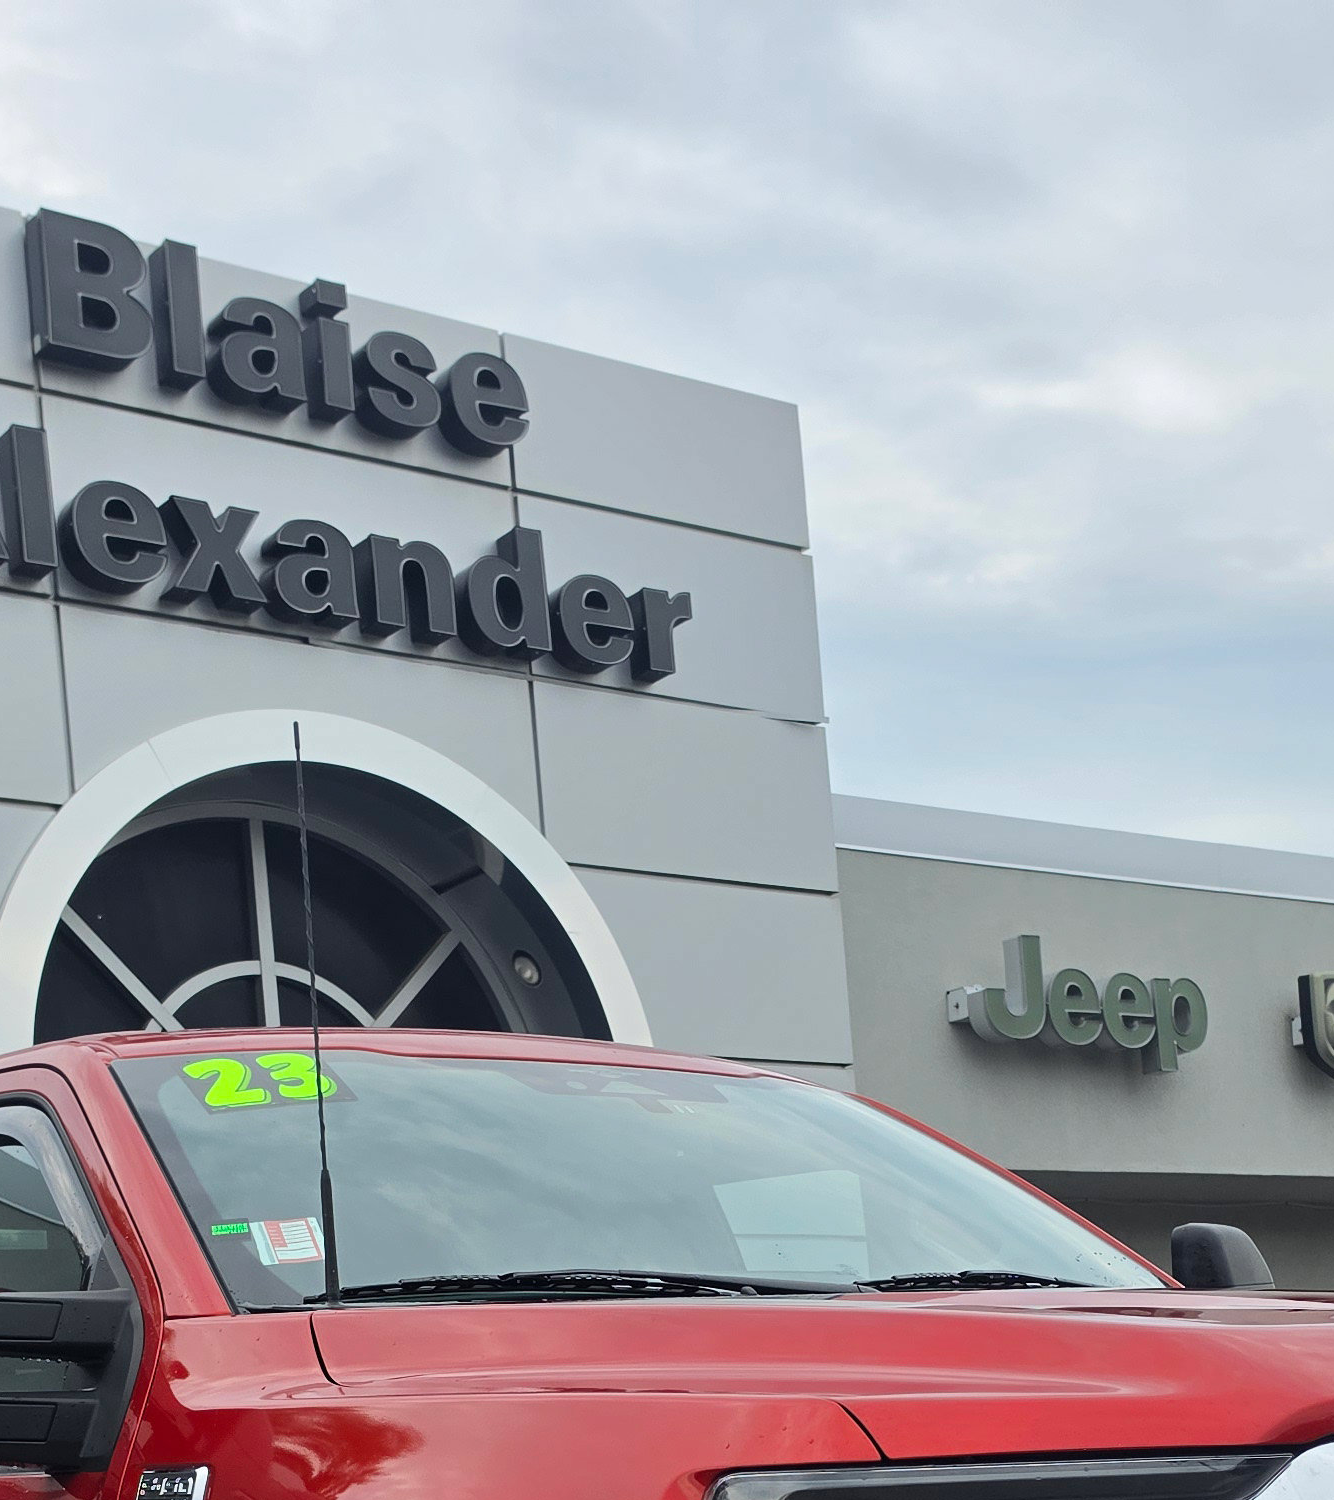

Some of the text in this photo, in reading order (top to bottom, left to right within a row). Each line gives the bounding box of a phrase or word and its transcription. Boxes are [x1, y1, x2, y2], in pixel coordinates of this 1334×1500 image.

[25, 207, 530, 459] Blaise
[969, 935, 1208, 1074] Jeep
[182, 1052, 338, 1107] 23
